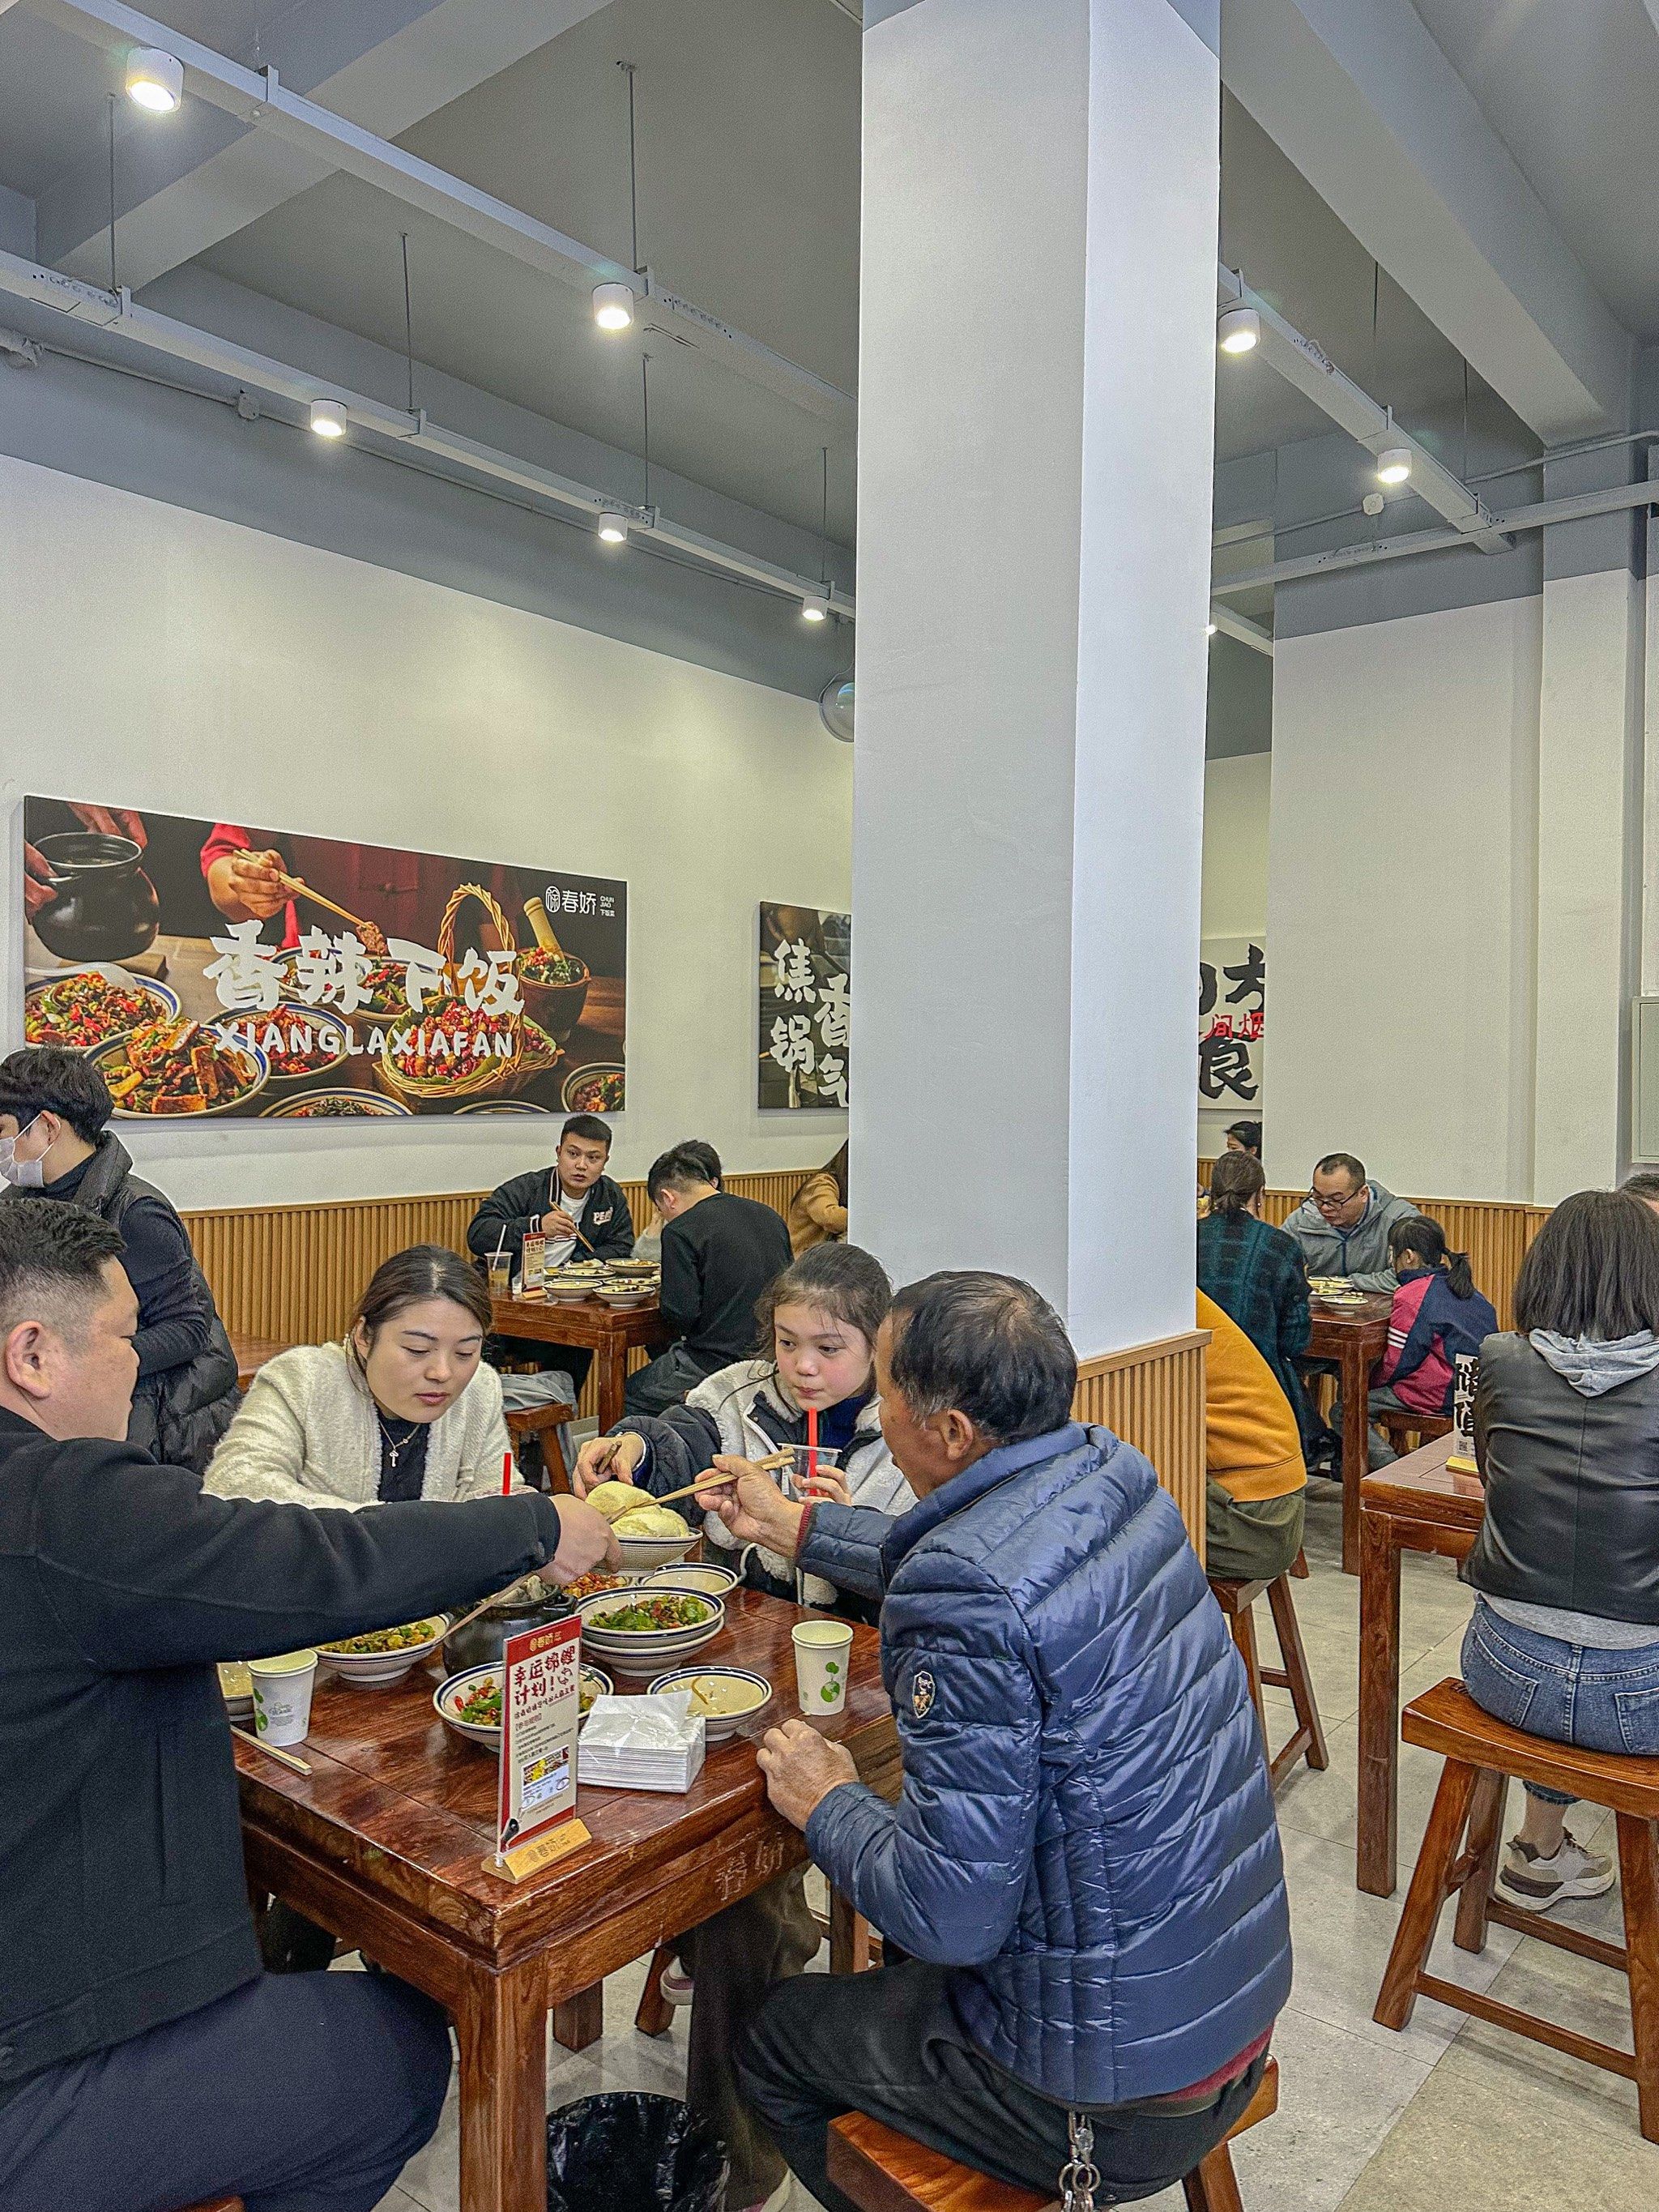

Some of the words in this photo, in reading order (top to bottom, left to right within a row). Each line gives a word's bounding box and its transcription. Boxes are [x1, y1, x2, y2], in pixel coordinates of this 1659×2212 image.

[561, 890, 597, 916] 春娇
[203, 919, 525, 1016] 香辣下饭
[214, 1021, 513, 1059] XIANGLAXIAFAN
[514, 1645, 575, 1688] 幸运锦鲤
